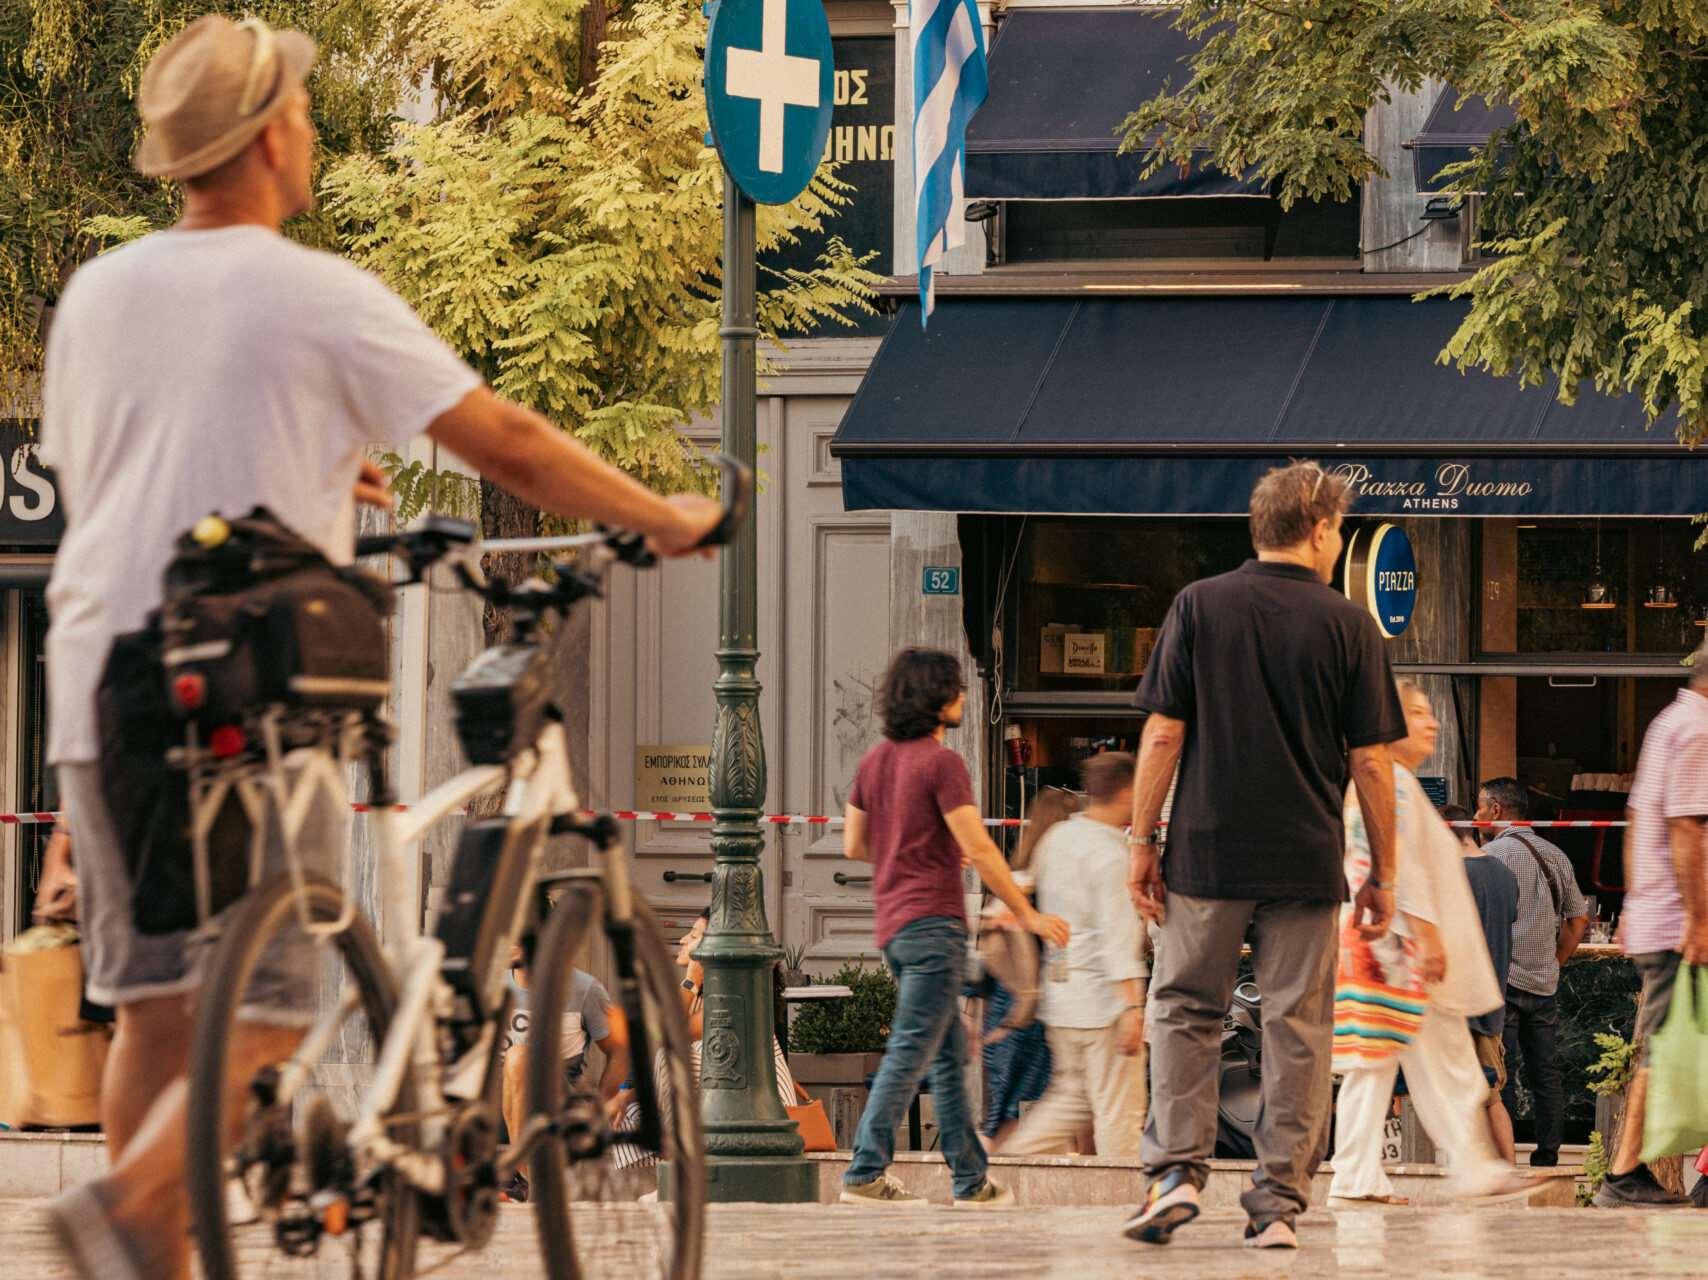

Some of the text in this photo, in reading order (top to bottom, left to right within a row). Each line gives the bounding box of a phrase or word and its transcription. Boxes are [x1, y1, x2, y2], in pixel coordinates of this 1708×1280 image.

[1333, 463, 1533, 497] Piazza Duomo
[1403, 498, 1459, 509] ATHENS
[931, 571, 950, 590] 52
[1378, 571, 1414, 592] PIAZZA
[644, 754, 690, 769] ΕΜΠΟΡΙΚΟΣ
